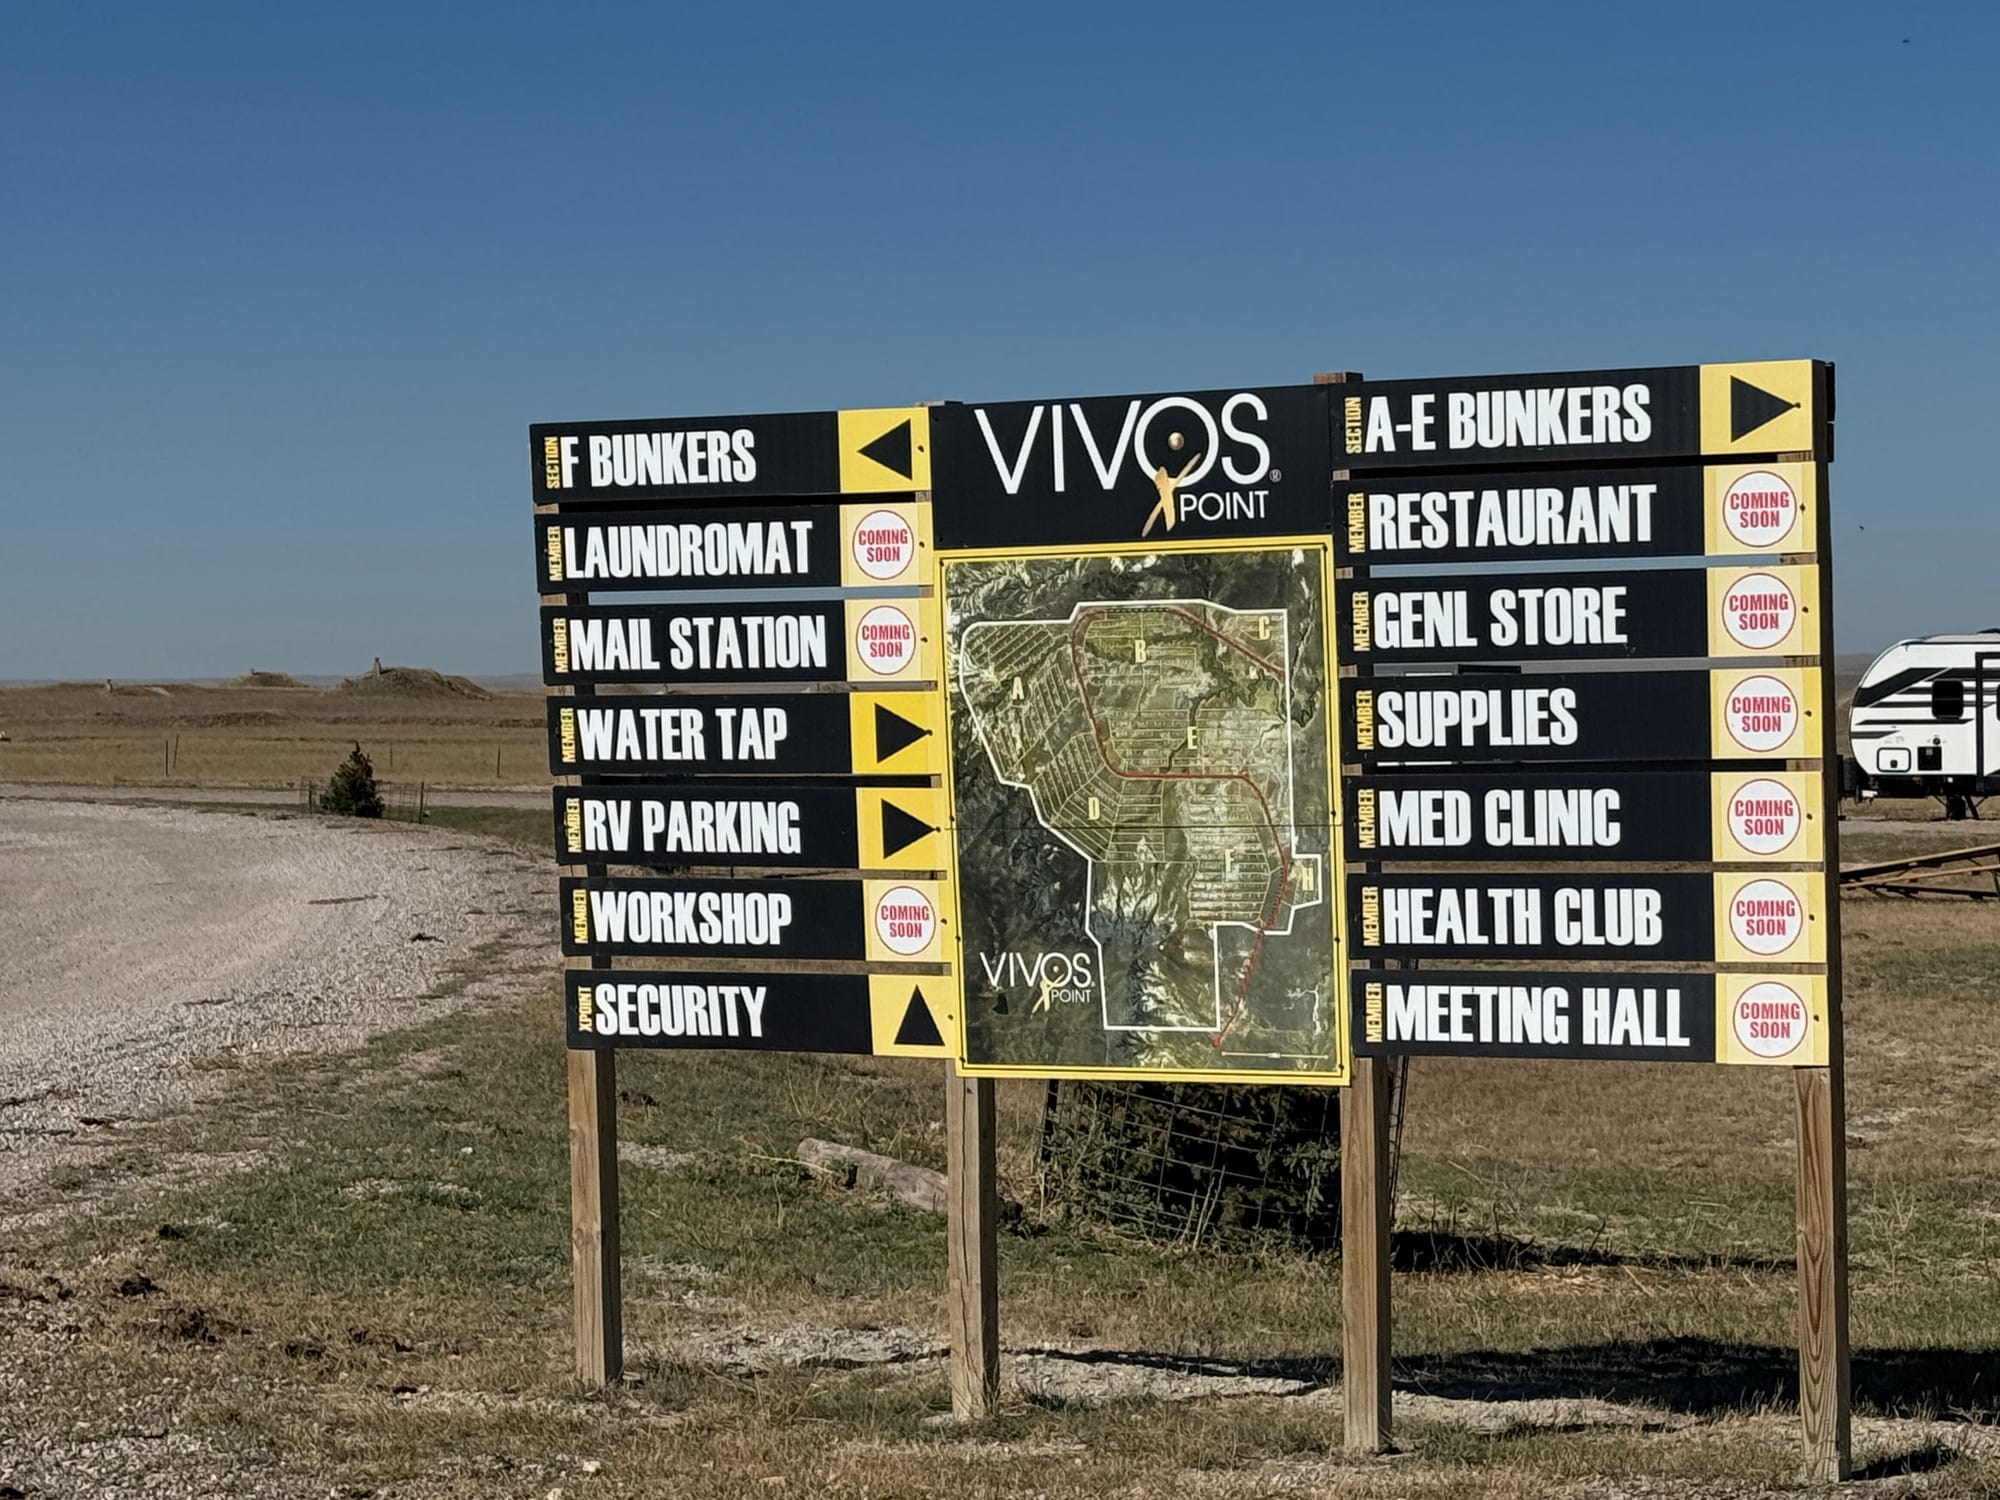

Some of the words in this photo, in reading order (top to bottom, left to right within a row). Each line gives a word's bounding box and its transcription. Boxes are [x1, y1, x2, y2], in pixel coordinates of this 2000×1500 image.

[1344, 397, 1362, 454] SECTION
[1365, 393, 1437, 453] A-E
[1448, 384, 1652, 450] BUNKERS
[546, 436, 558, 489] SECTION
[560, 437, 578, 488] F
[589, 429, 757, 487] BUNKERS
[1180, 490, 1270, 522] POINT
[1348, 492, 1365, 553] MEMBER
[1369, 484, 1657, 551] RESTAURANT
[1730, 491, 1790, 510] COMING
[1739, 511, 1781, 529] SOON
[548, 525, 562, 582] MEMBER
[564, 521, 813, 579] LAUNDROMAT
[858, 528, 909, 547] COMING
[866, 546, 901, 563] SOON
[1258, 616, 1271, 640] C
[1353, 591, 1369, 652] MEMBER
[1373, 590, 1478, 649] GENL
[1489, 586, 1629, 647] STORE
[1728, 594, 1789, 613] COMING
[1738, 613, 1780, 631] SOON
[555, 617, 568, 673] MEMBER
[570, 618, 661, 672] MAIL
[669, 615, 827, 670] STATION
[861, 624, 910, 641] COMING
[869, 641, 903, 658] SOON
[1134, 639, 1147, 663] B
[1012, 677, 1025, 700] A
[1731, 696, 1791, 714] COMING
[561, 707, 576, 763] MEMBER
[576, 707, 705, 761] WATER
[715, 707, 787, 761] TAP
[1356, 689, 1374, 751] MEMBER
[1377, 688, 1579, 748] SUPPLIES
[1741, 715, 1782, 733] SOON
[567, 797, 582, 853] MEMBER
[583, 800, 632, 852] RV
[641, 800, 801, 854] PARKING
[1358, 789, 1375, 849] MEMBER
[1379, 790, 1472, 847] MED
[1484, 788, 1621, 848] CLINIC
[1734, 800, 1794, 818] COMING
[1743, 818, 1784, 836] SOON
[589, 891, 792, 945] WORKSHOP
[880, 905, 930, 922] COMING
[889, 922, 923, 938] SOON
[1362, 886, 1380, 947] MEMBER
[1383, 888, 1541, 946] HEALTH
[1554, 888, 1663, 947] CLUB
[1735, 900, 1795, 918] COMING
[1746, 918, 1786, 936] SOON
[979, 952, 1092, 988] VIVOS
[1051, 989, 1092, 1003] POINT
[595, 984, 767, 1037] SECURITY
[1365, 982, 1382, 1044] MEMBER
[1385, 984, 1569, 1045] MEETING
[1581, 988, 1690, 1048] HALL
[1740, 1002, 1800, 1021] COMING
[1749, 1020, 1791, 1039] SOON
